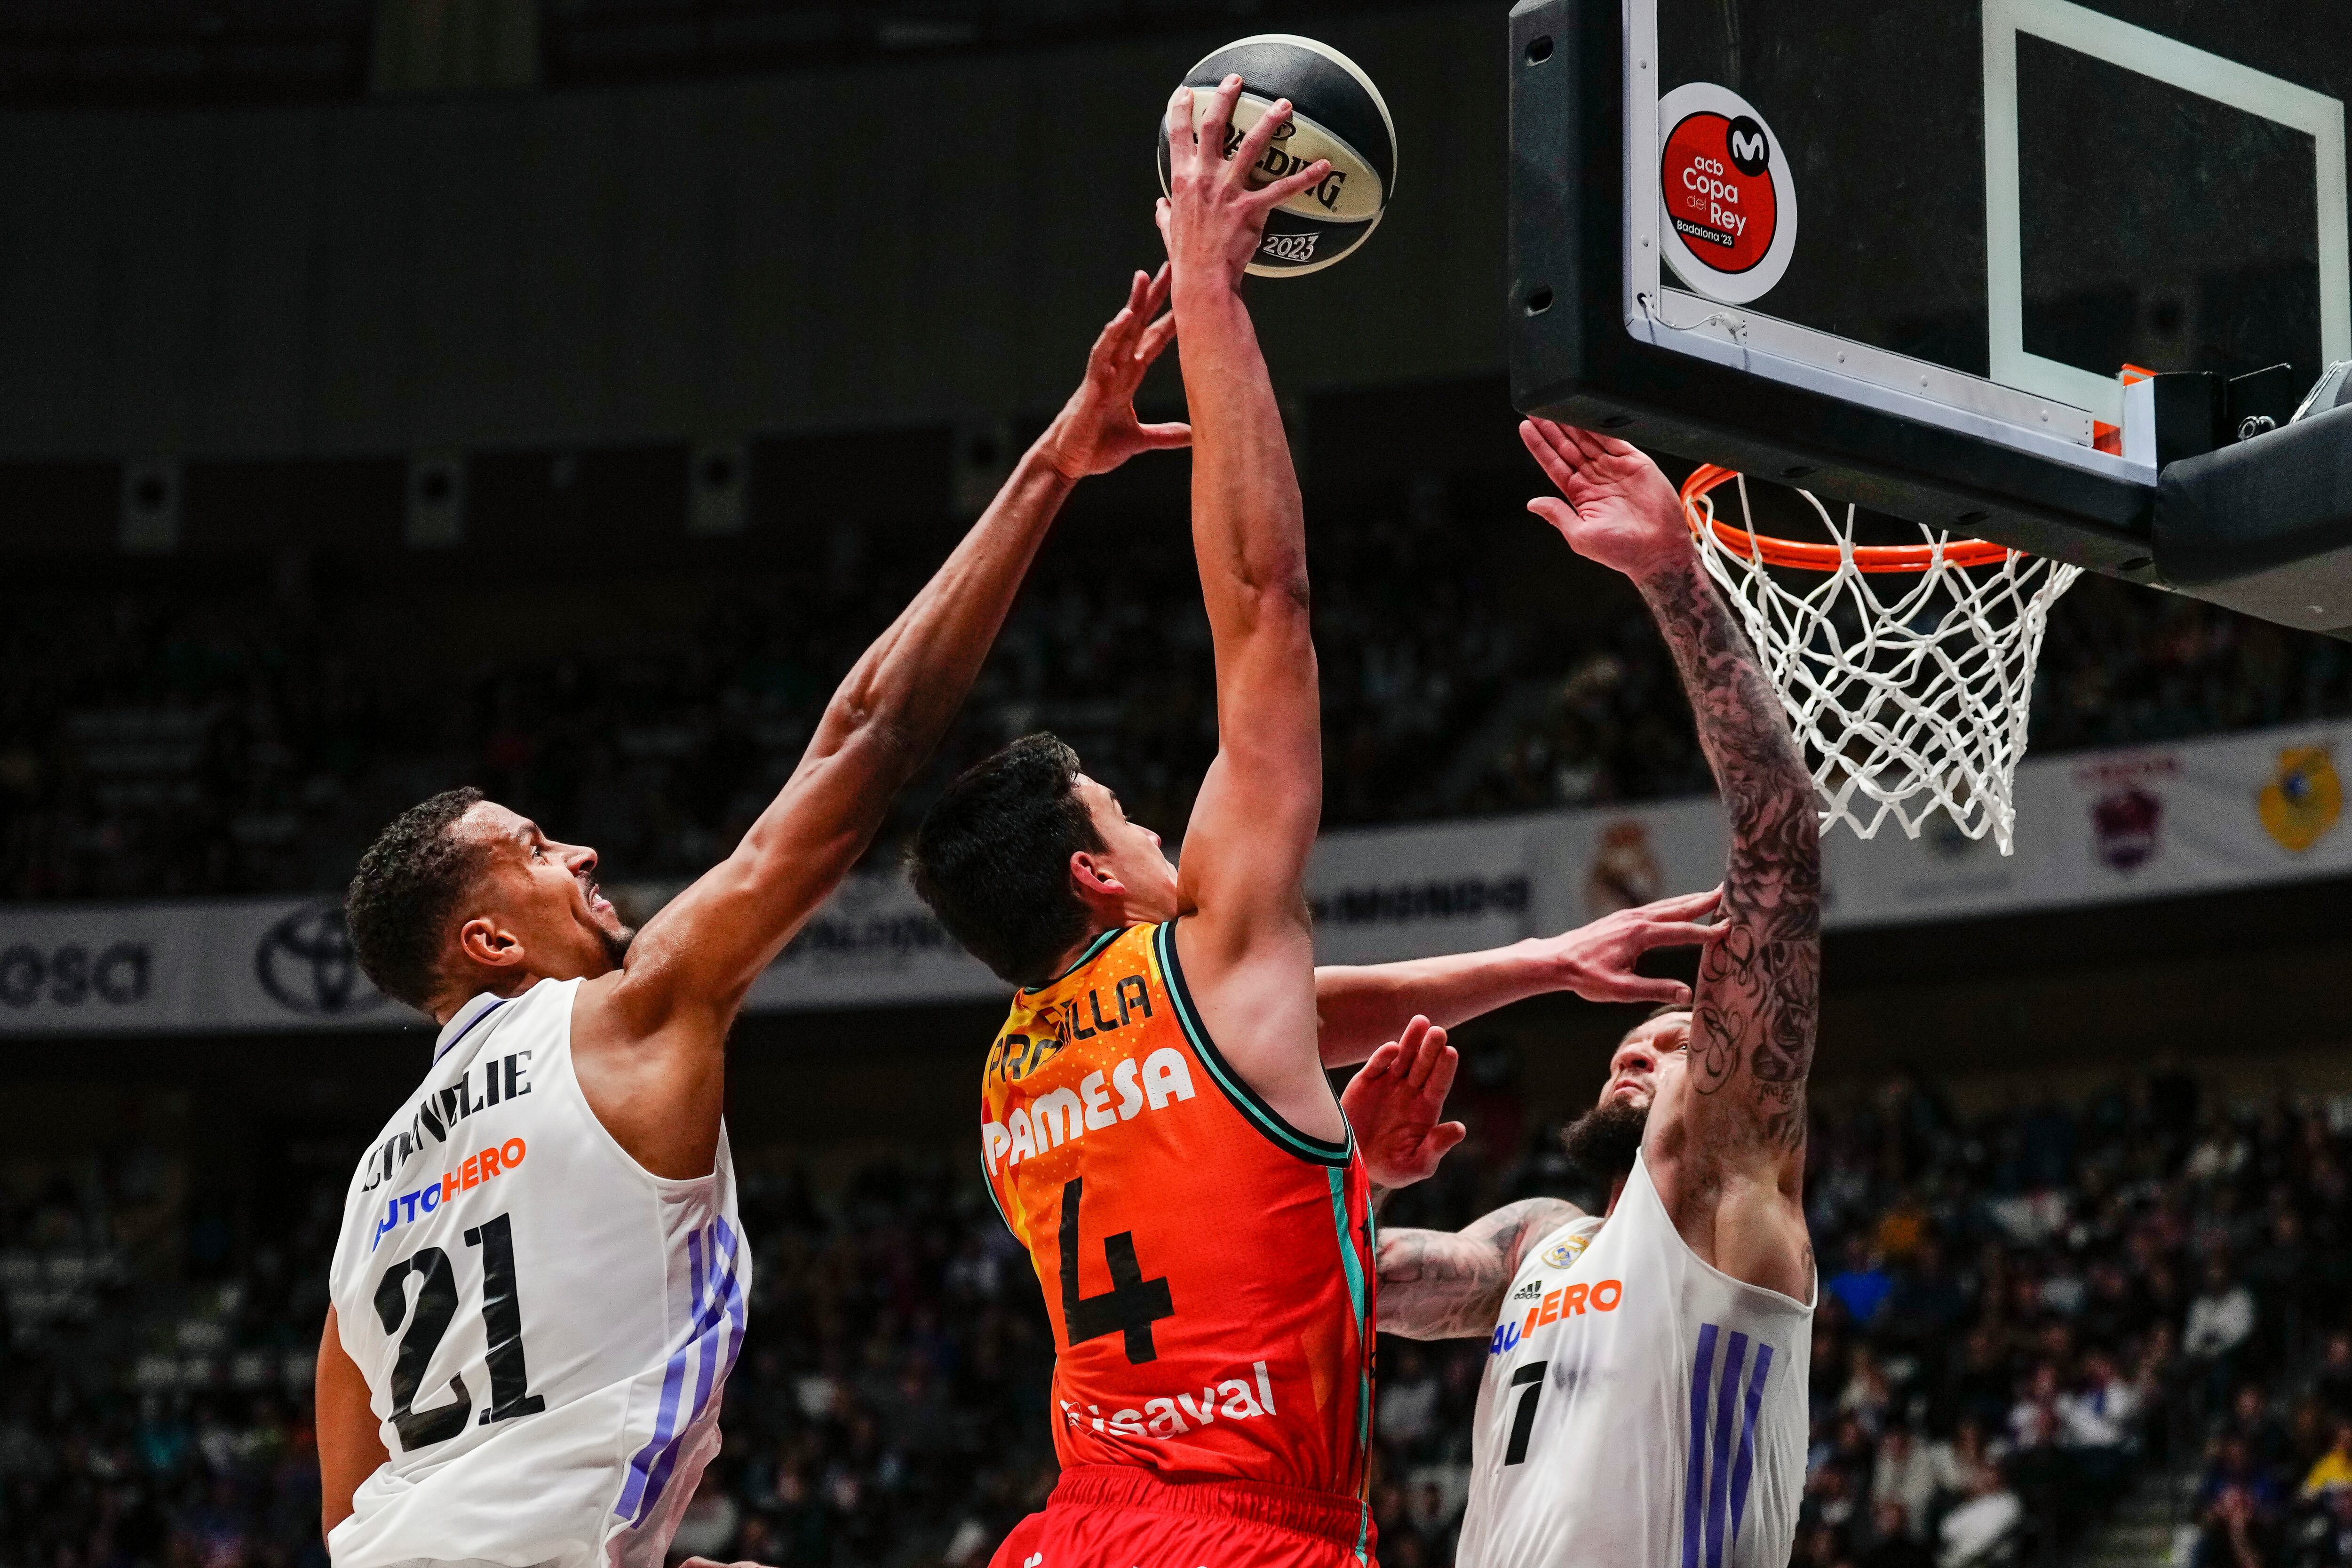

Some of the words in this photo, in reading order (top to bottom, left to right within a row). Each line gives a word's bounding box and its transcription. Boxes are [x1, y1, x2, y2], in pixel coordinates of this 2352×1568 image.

[1683, 167, 1738, 204] Copa
[1694, 156, 1724, 176] acb
[1677, 219, 1720, 242] Badalona
[1687, 194, 1707, 211] del
[1710, 202, 1747, 237] Rey
[1263, 235, 1314, 261] 2023
[361, 1050, 532, 1193] CONELIE
[982, 1047, 1196, 1177] PAMESA
[1058, 1176, 1175, 1365] 4
[373, 1212, 546, 1453] 21
[1490, 1279, 1622, 1355] AUERO
